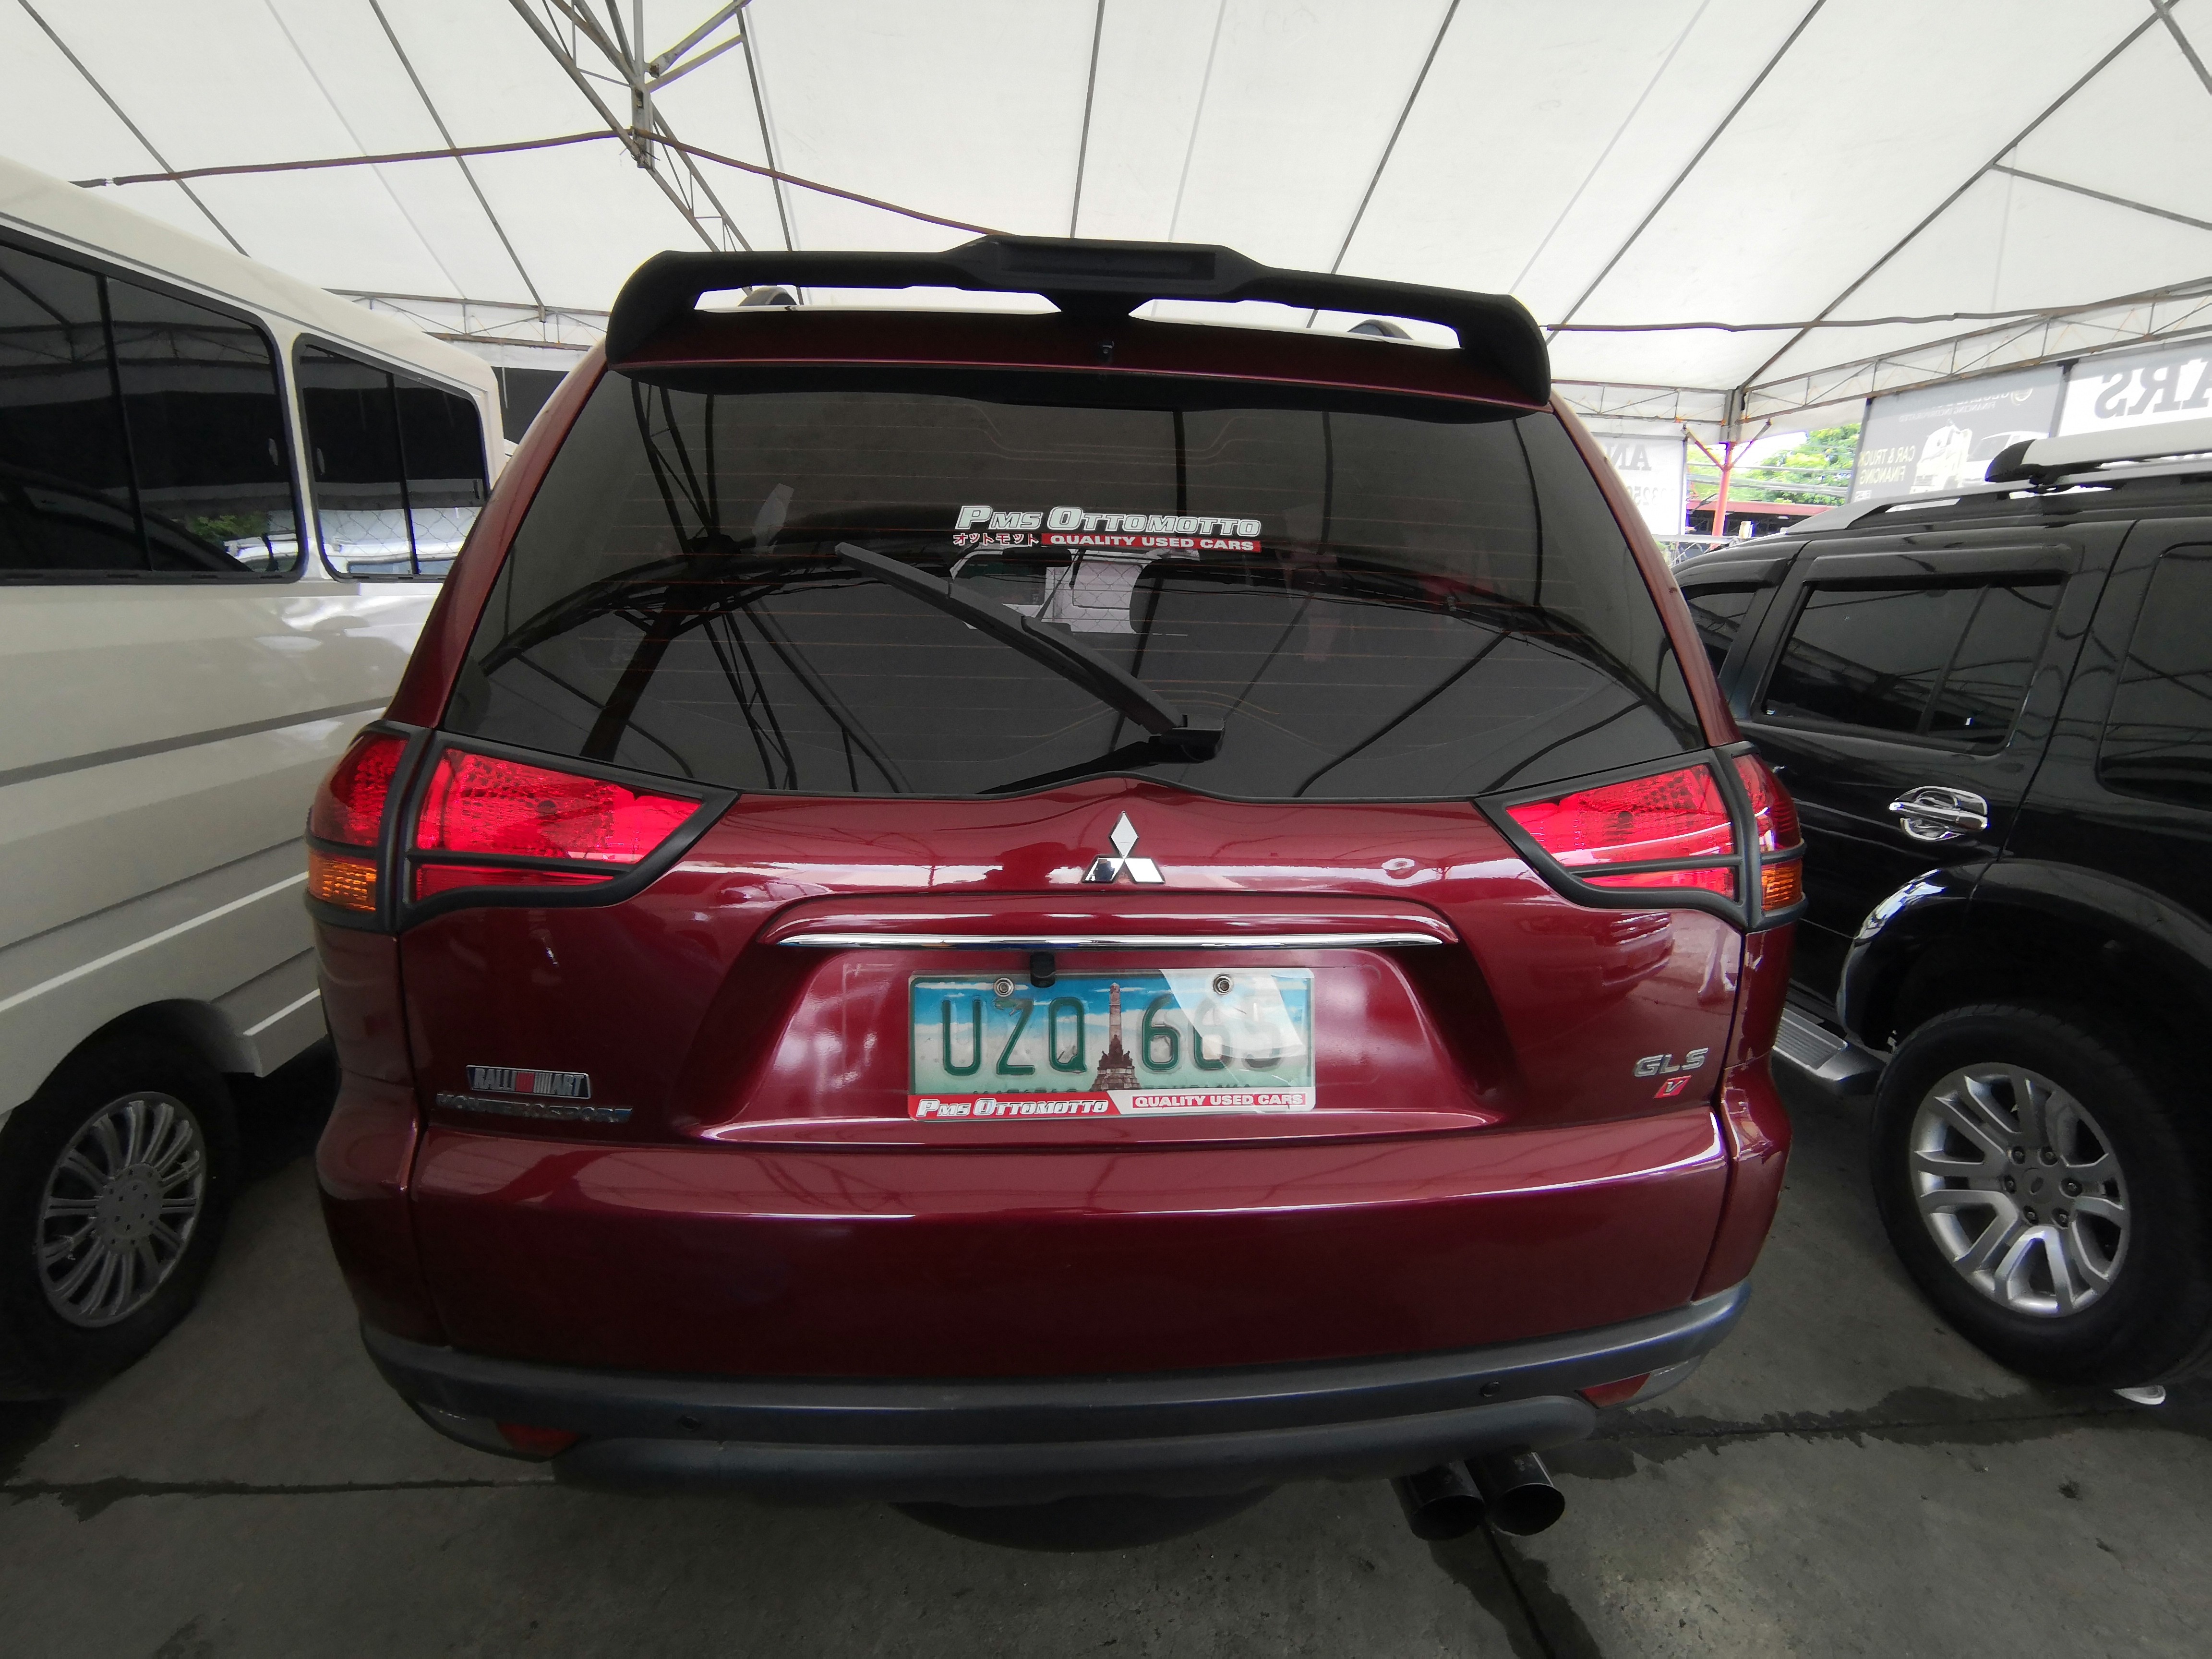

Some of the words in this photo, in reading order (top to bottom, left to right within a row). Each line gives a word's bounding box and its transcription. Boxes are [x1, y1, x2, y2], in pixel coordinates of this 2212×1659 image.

[1050, 535, 1136, 546] QUALITY
[1142, 536, 1194, 548] USED
[1200, 540, 1254, 551] CARS
[940, 996, 1087, 1076] UZQ
[1634, 1047, 1708, 1077] GLS
[1135, 1095, 1206, 1107] QUALITY
[1210, 1094, 1254, 1106] USED
[1258, 1094, 1303, 1106] CARS
